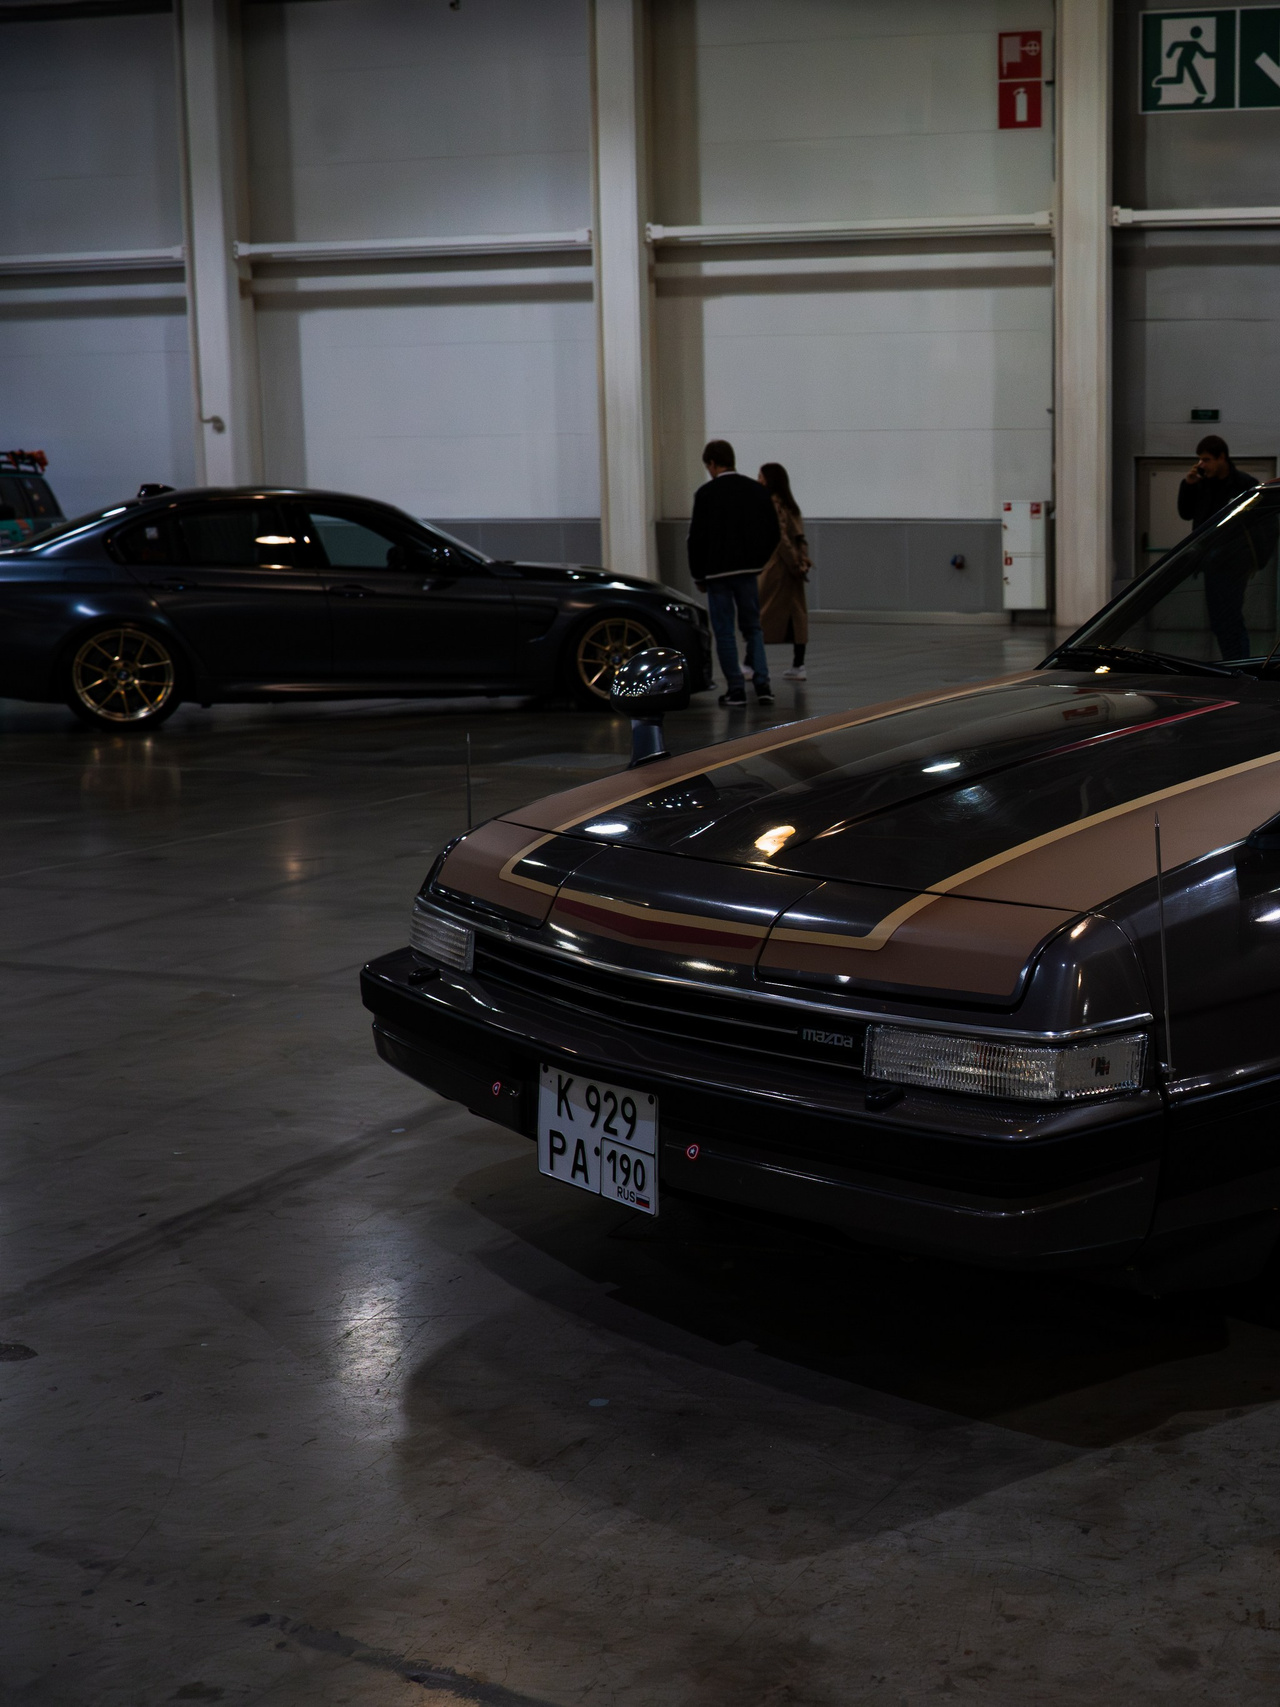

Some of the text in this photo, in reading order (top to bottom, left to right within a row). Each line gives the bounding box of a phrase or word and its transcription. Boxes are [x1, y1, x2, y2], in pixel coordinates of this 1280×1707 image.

[802, 1028, 854, 1048] mazda
[557, 1074, 637, 1140] K 929
[548, 1129, 589, 1184] PA
[606, 1149, 645, 1191] 190
[617, 1186, 636, 1203] RUS
